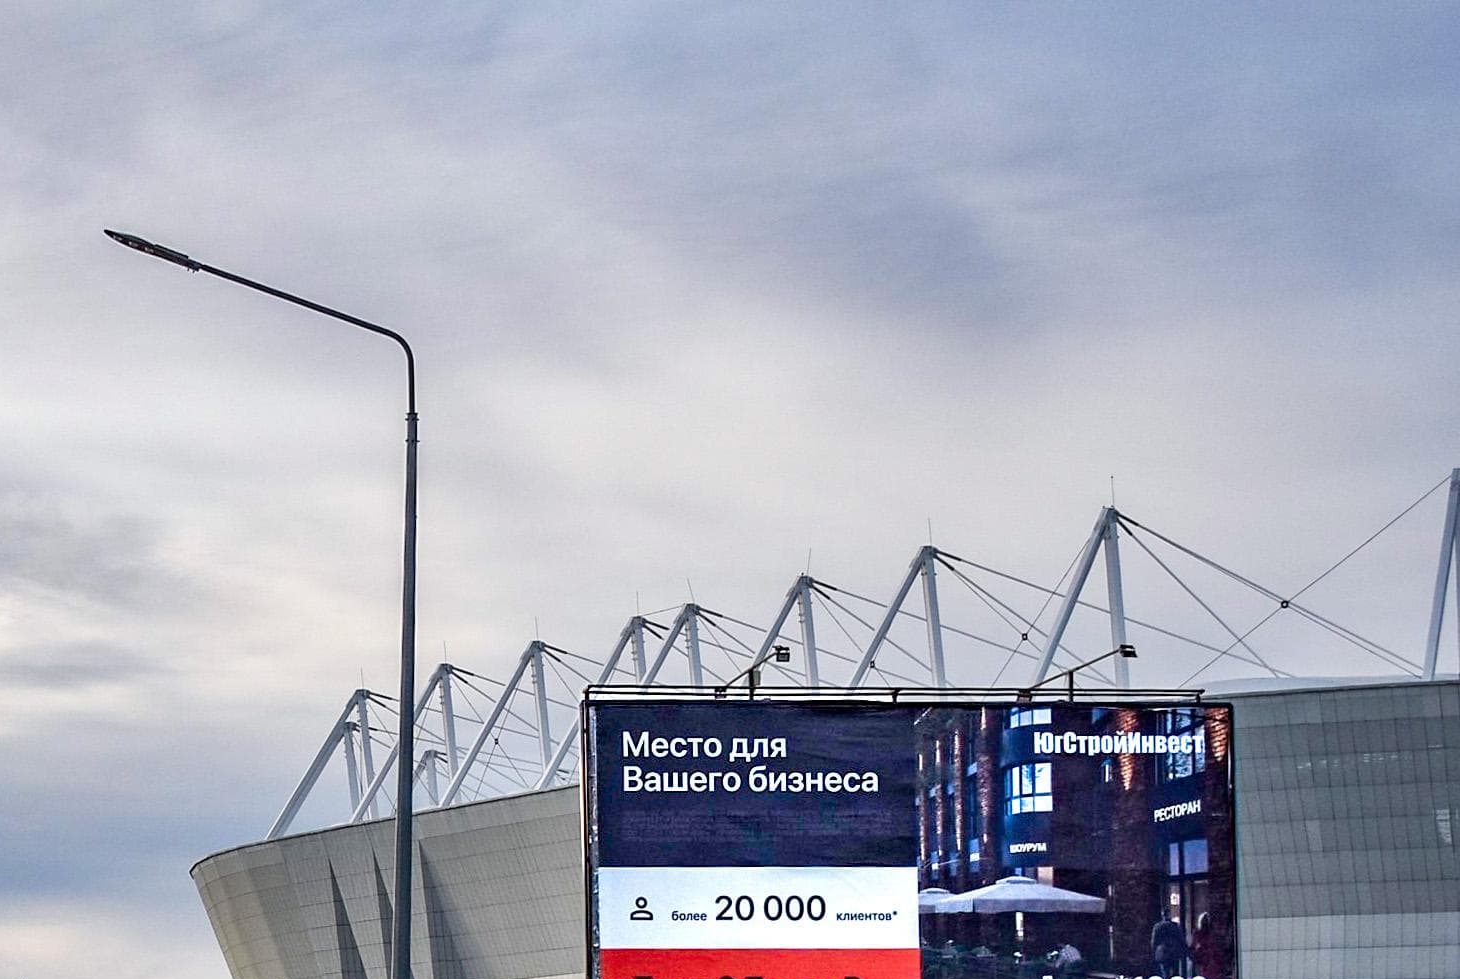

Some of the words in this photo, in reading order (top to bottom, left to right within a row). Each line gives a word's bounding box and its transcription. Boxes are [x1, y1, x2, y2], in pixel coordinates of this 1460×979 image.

[622, 731, 722, 758] Место
[729, 738, 787, 762] для
[1033, 731, 1205, 755] ЮгСтройИнвест
[623, 766, 741, 792] Вашего
[748, 766, 879, 792] бизнеса
[1153, 800, 1201, 822] РЕСТОРАН
[671, 910, 707, 921] более
[715, 895, 755, 921] 20
[763, 895, 826, 921] 000
